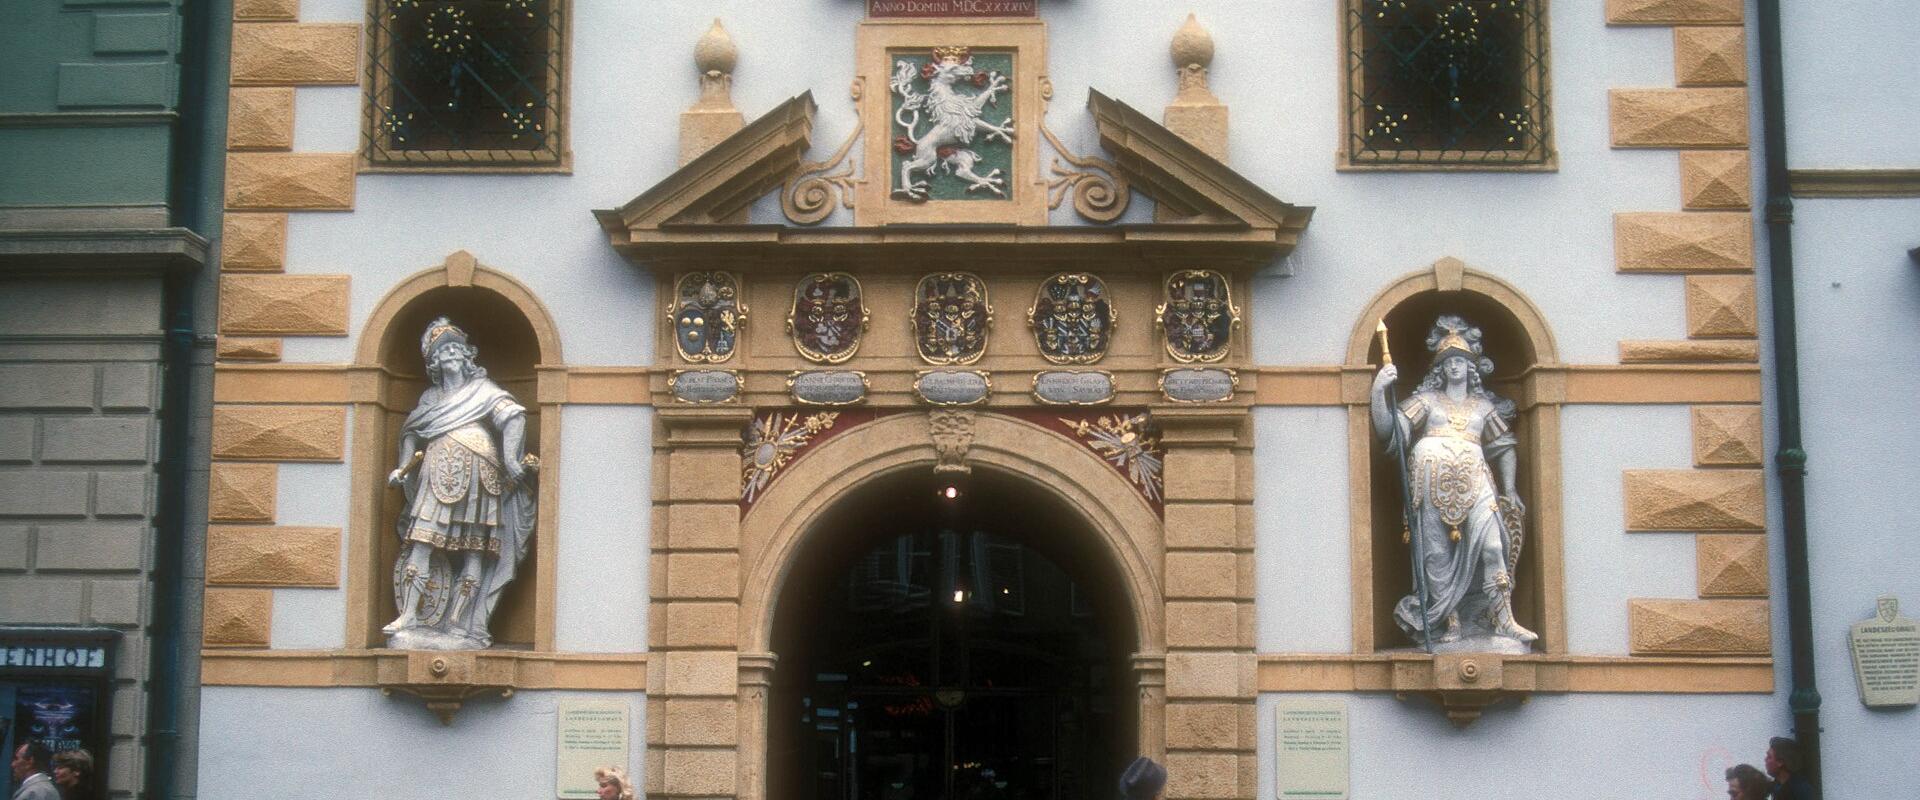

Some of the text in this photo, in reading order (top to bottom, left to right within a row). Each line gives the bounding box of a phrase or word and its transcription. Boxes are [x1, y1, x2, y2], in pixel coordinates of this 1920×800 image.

[872, 1, 905, 12] ANNO
[907, 0, 947, 12] DOMINI
[6, 648, 98, 667] ENHOF
